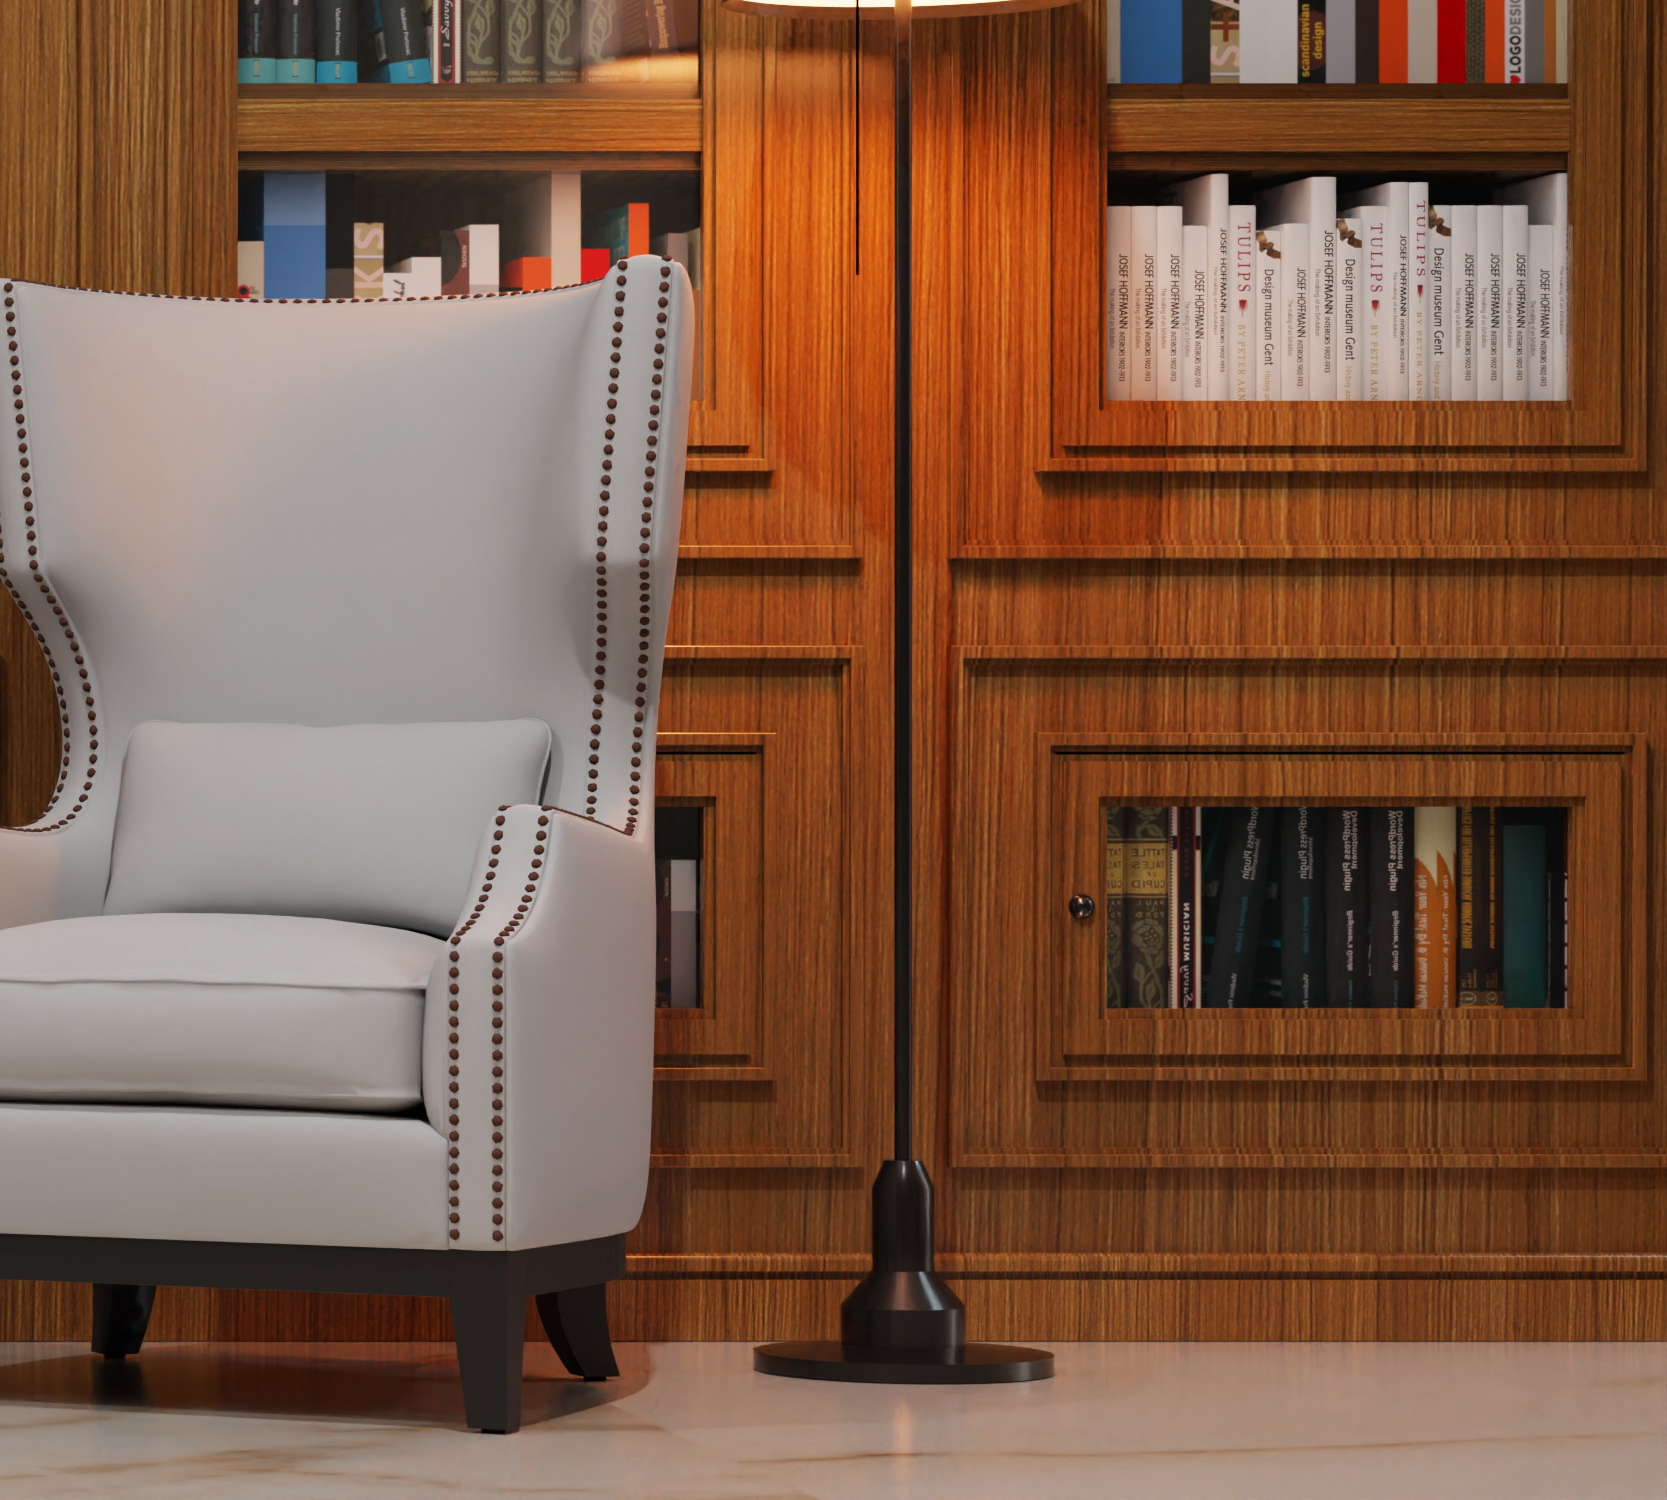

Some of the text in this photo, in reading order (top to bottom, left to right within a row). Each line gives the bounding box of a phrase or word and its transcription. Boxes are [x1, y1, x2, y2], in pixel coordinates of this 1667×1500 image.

[441, 2, 453, 44] Savvy
[1300, 2, 1311, 79] scandinavian
[1312, 20, 1325, 61] design
[1238, 222, 1250, 291] TULIPS
[1324, 231, 1334, 257] JOSEF
[1325, 260, 1333, 314] HOFFMANN
